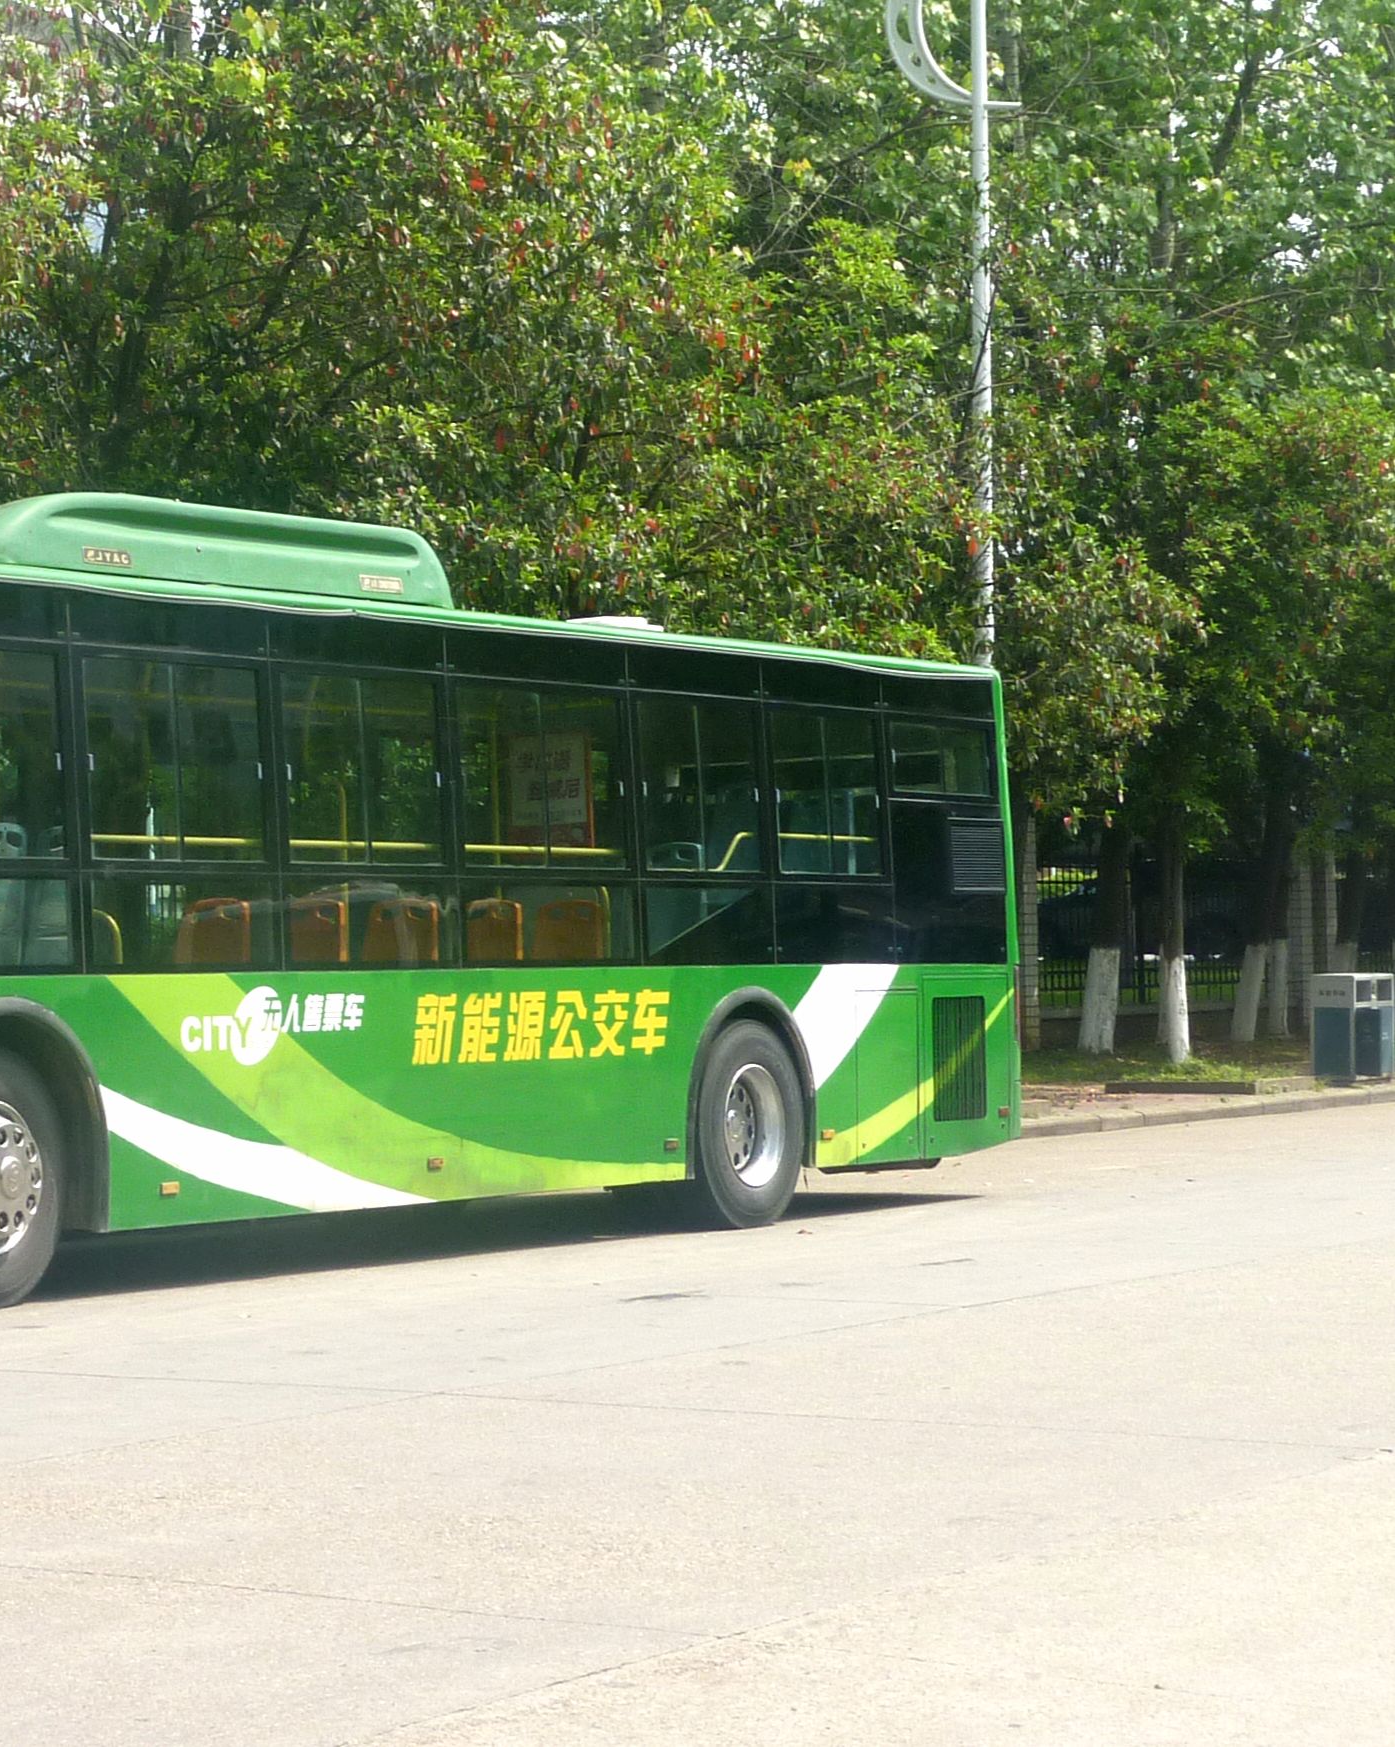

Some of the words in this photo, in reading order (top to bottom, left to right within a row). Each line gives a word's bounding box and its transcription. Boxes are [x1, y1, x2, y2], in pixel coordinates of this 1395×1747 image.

[180, 1014, 253, 1053] CITY
[411, 988, 671, 1066] 新能源公交车
